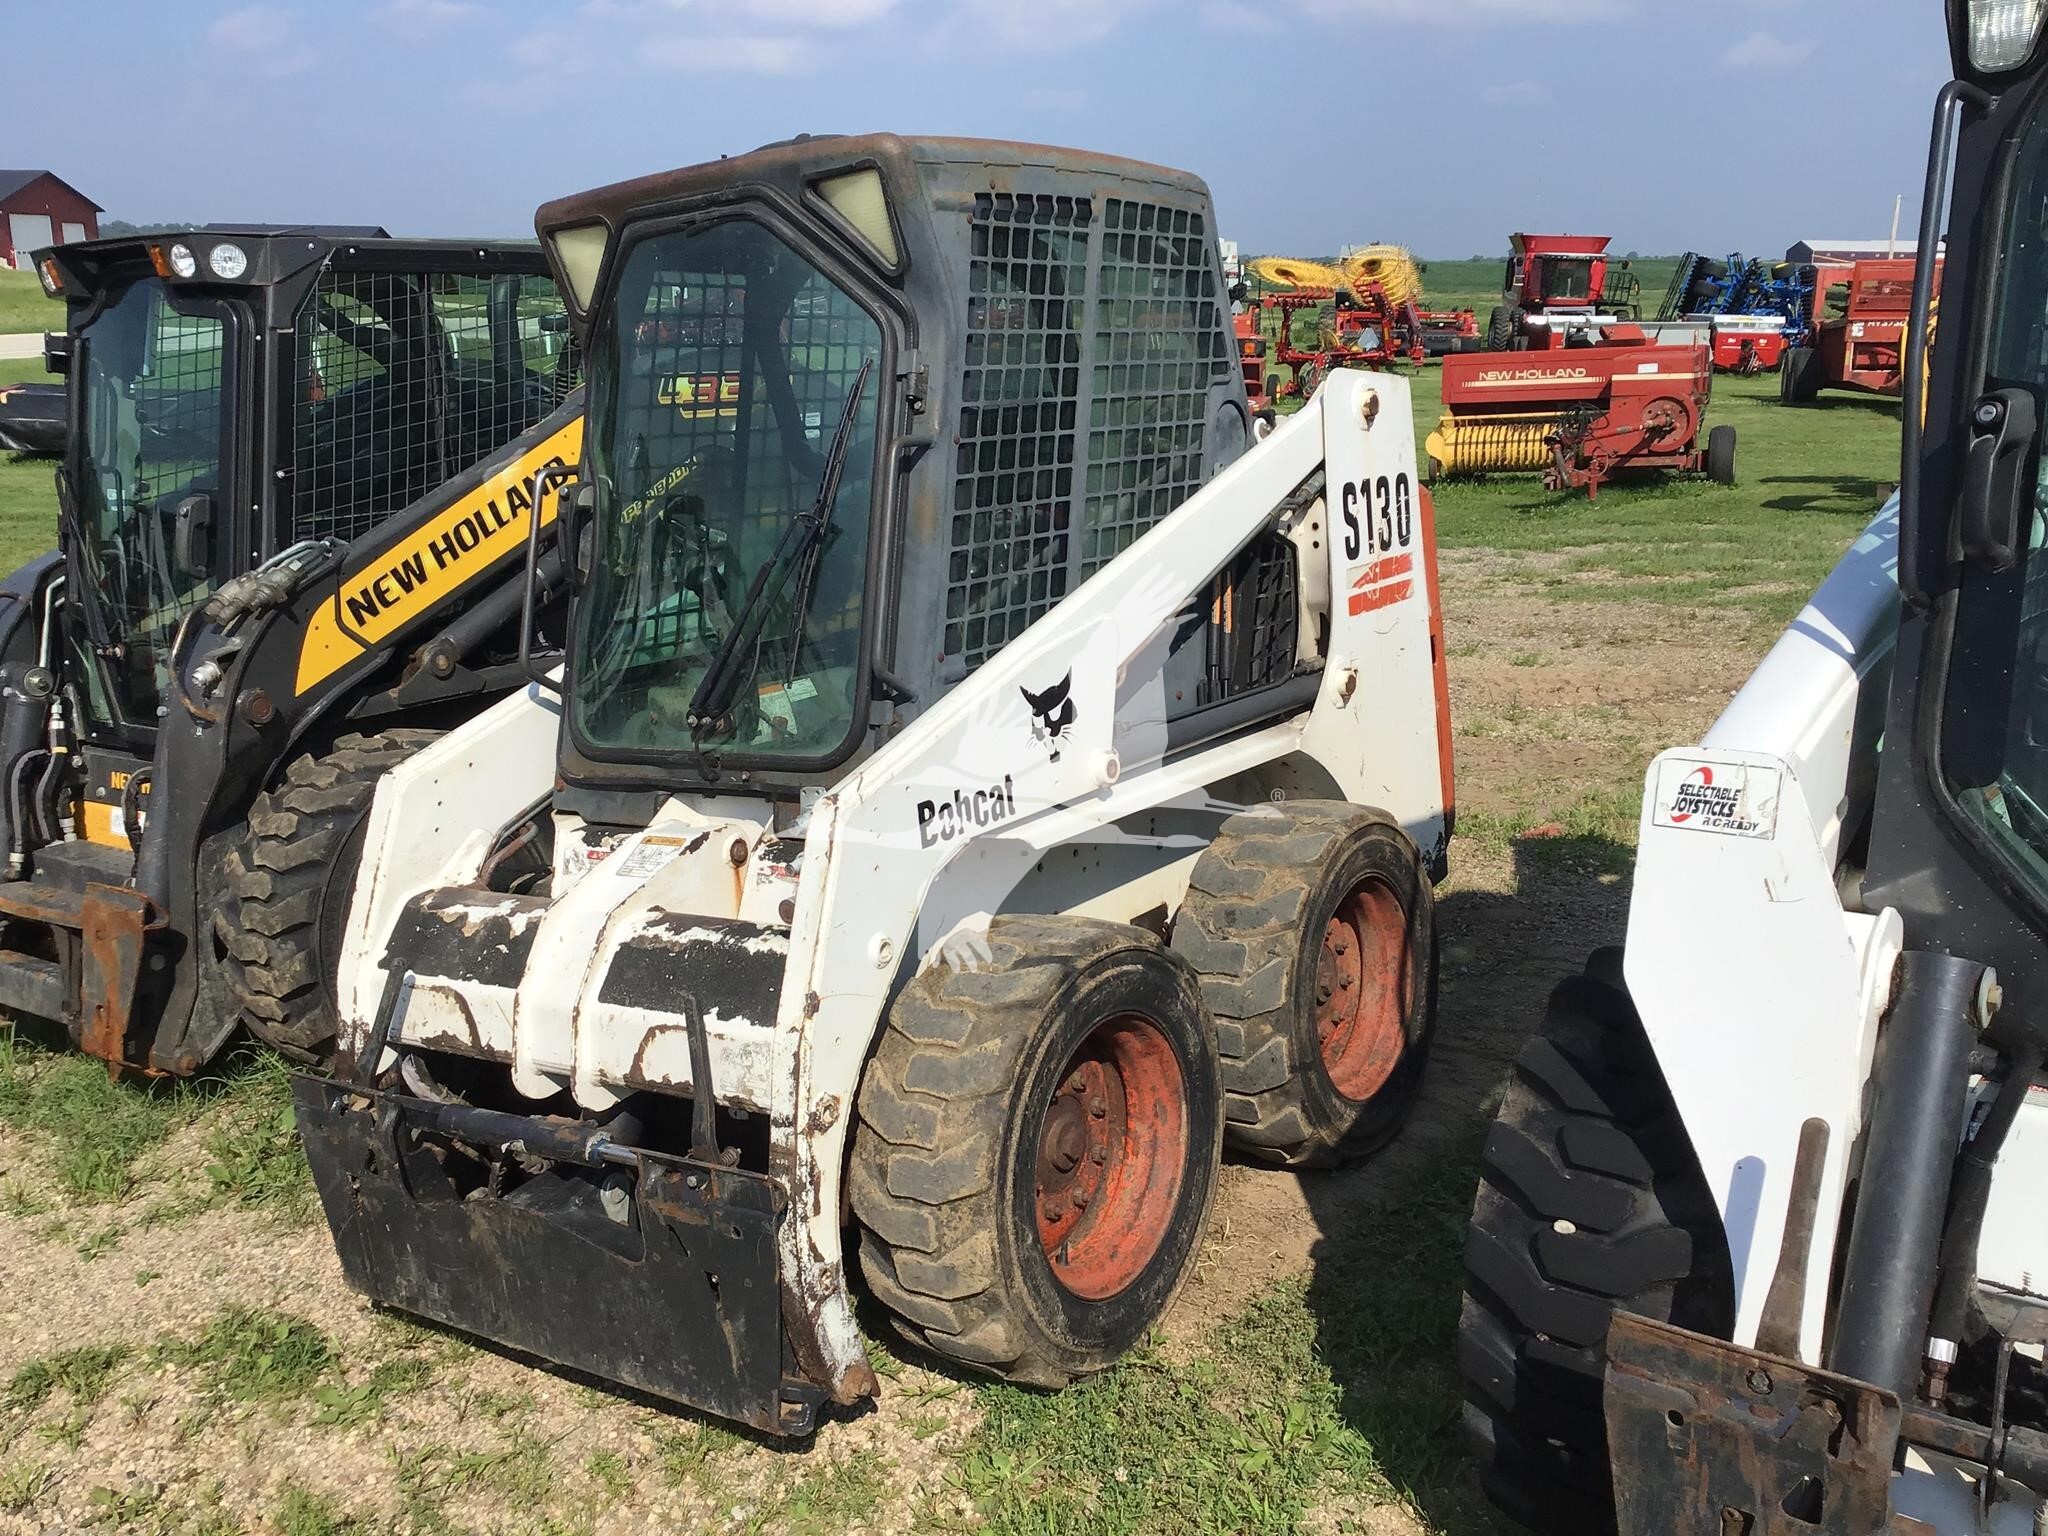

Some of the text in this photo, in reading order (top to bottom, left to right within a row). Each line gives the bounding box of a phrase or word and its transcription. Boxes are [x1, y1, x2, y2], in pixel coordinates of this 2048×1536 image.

[1479, 368, 1587, 381] NEW HOLLAND
[1342, 472, 1411, 560] S130
[346, 456, 569, 628] NEW HOLLAND
[1678, 783, 1742, 801] SELECTABLE
[917, 773, 1016, 849] Bobcat
[1670, 796, 1737, 818] JOYSTICKS
[1723, 818, 1760, 832] READY
